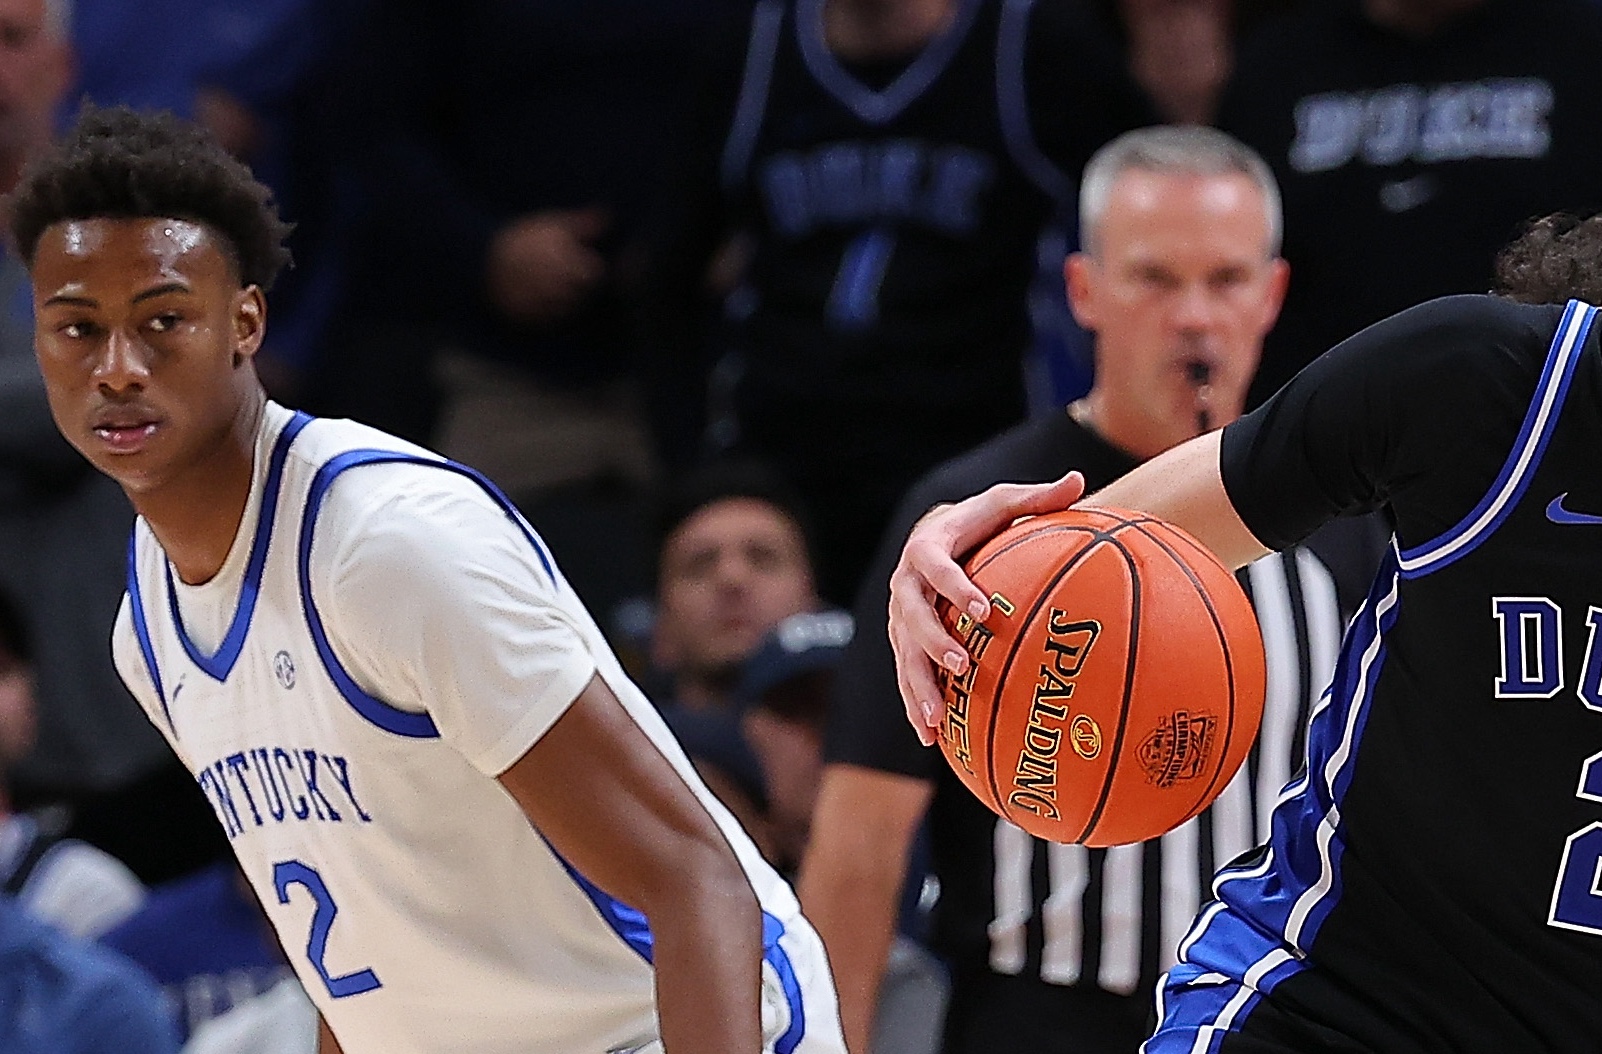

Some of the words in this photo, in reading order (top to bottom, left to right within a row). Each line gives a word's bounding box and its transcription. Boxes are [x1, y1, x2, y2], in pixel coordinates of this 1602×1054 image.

[1007, 605, 1102, 823] SPALDING
[199, 746, 373, 838] NTUCKY
[272, 859, 383, 998] 2
